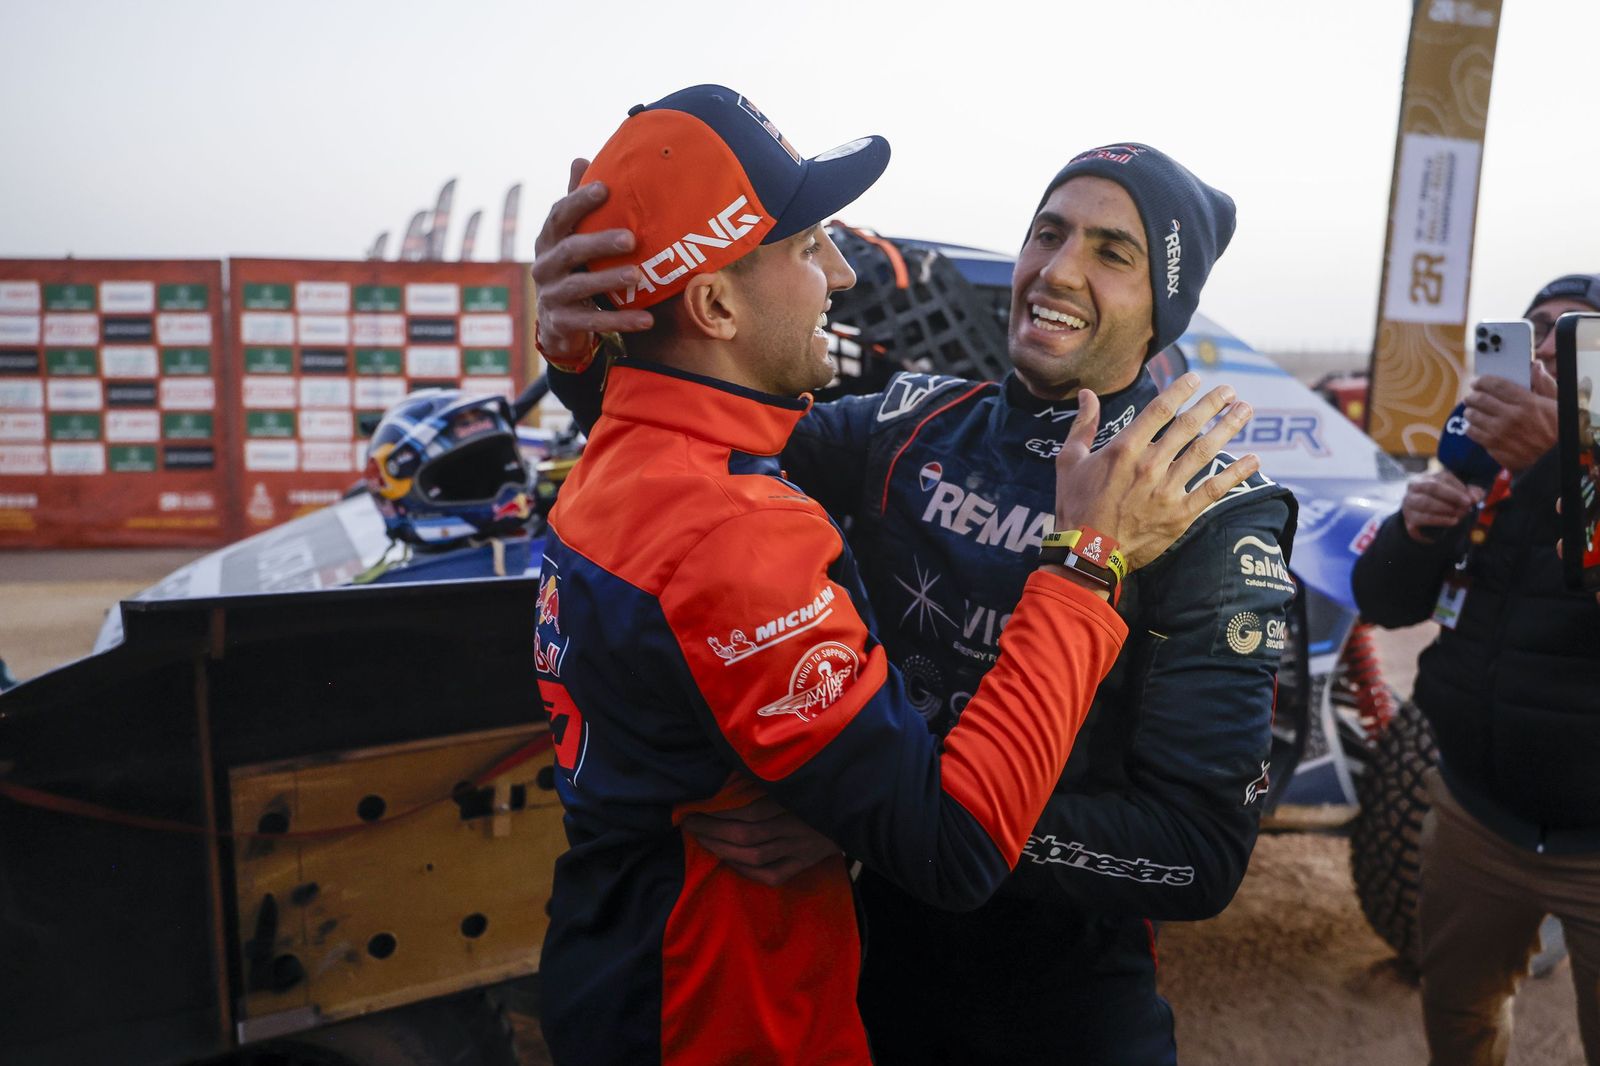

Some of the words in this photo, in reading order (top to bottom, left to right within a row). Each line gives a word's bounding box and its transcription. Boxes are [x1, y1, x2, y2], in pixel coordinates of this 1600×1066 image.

[1164, 231, 1181, 299] REMAX
[921, 481, 1056, 553] REMA
[755, 585, 835, 643] MICHLIN
[796, 662, 814, 689] PROUD
[811, 652, 822, 663] TO
[821, 648, 851, 663] SUPPORT
